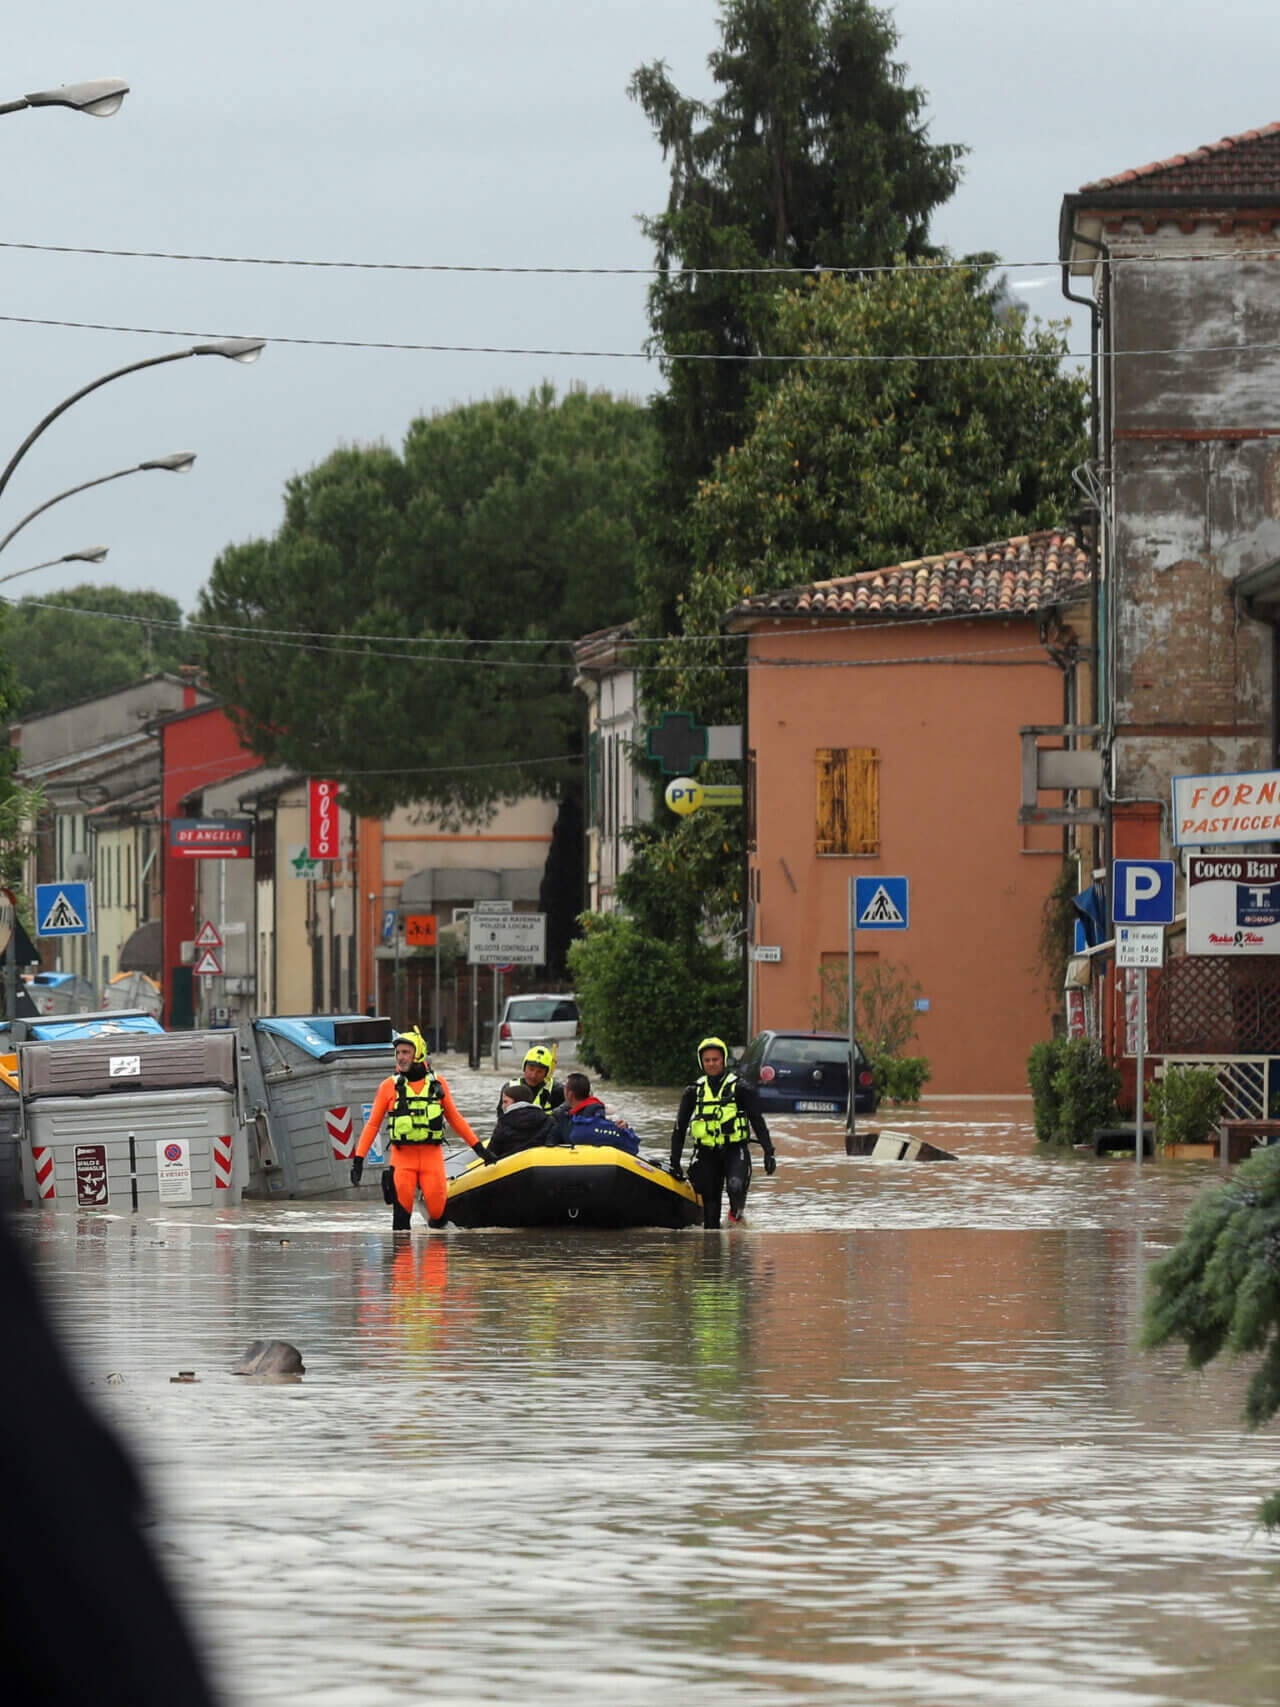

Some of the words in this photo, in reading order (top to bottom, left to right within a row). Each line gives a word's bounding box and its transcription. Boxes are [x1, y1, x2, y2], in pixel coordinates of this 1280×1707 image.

[672, 789, 696, 803] PT
[1191, 782, 1280, 809] FORN
[180, 832, 193, 841] DE
[1195, 862, 1241, 878] Cocco
[1247, 862, 1278, 878] Bar
[1126, 867, 1161, 916] P
